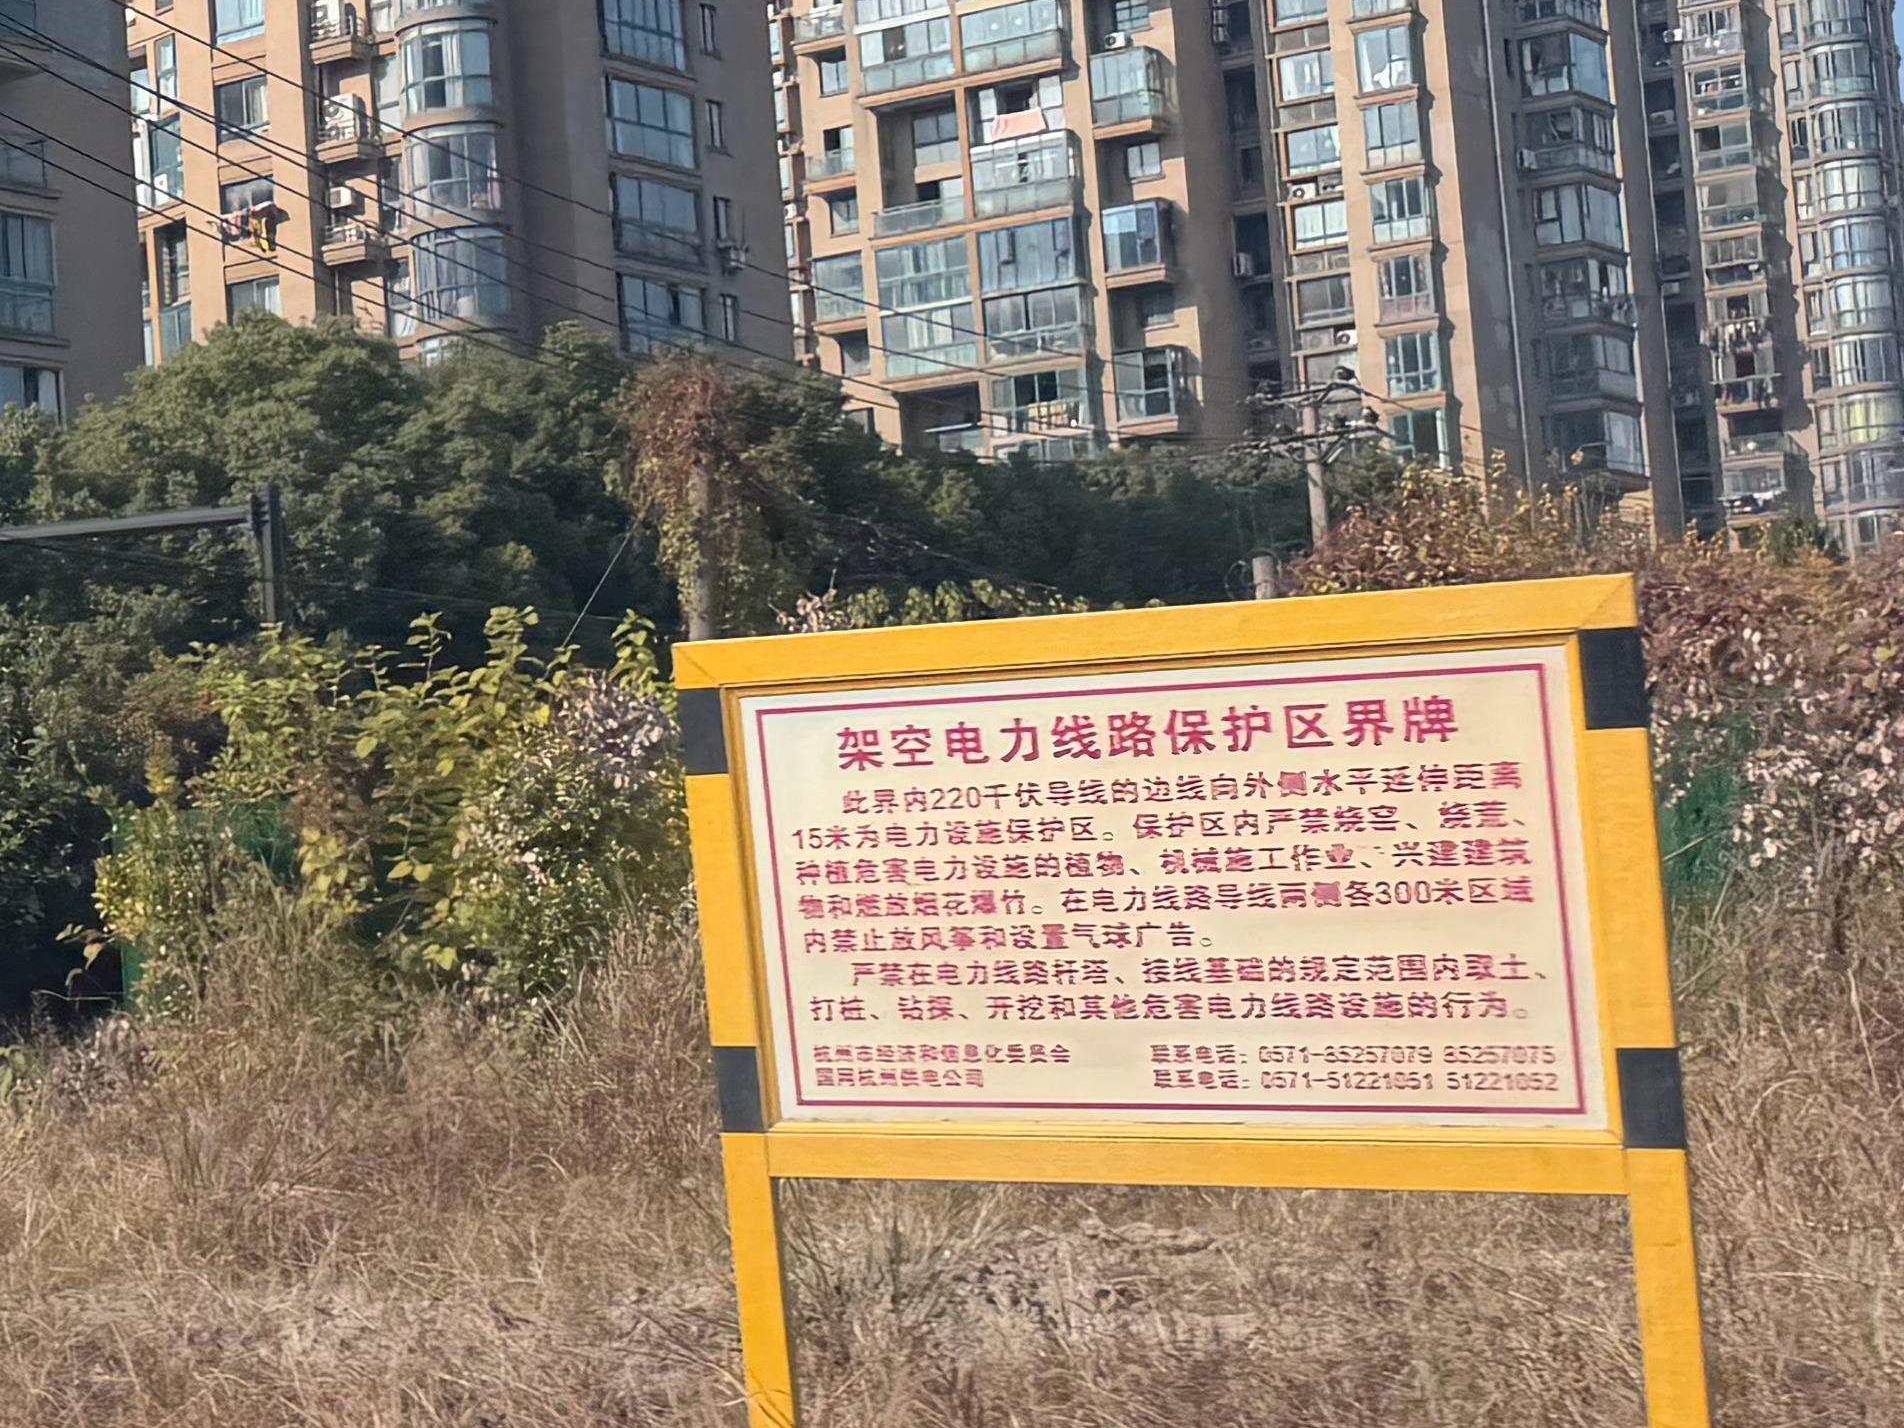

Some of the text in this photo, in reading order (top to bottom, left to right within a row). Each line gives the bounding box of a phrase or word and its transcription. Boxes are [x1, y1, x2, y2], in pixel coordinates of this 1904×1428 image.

[835, 695, 1460, 771] 架空电力线路保护区界牌
[841, 760, 1524, 814] 此界内220千伏导线的边线向外侧水平延伸距离
[803, 921, 1214, 954] 内禁止放风筝和设置气球广告。
[809, 991, 1530, 1022] 打桩、钻探、开挖和其他危害电力线路设施的行为。
